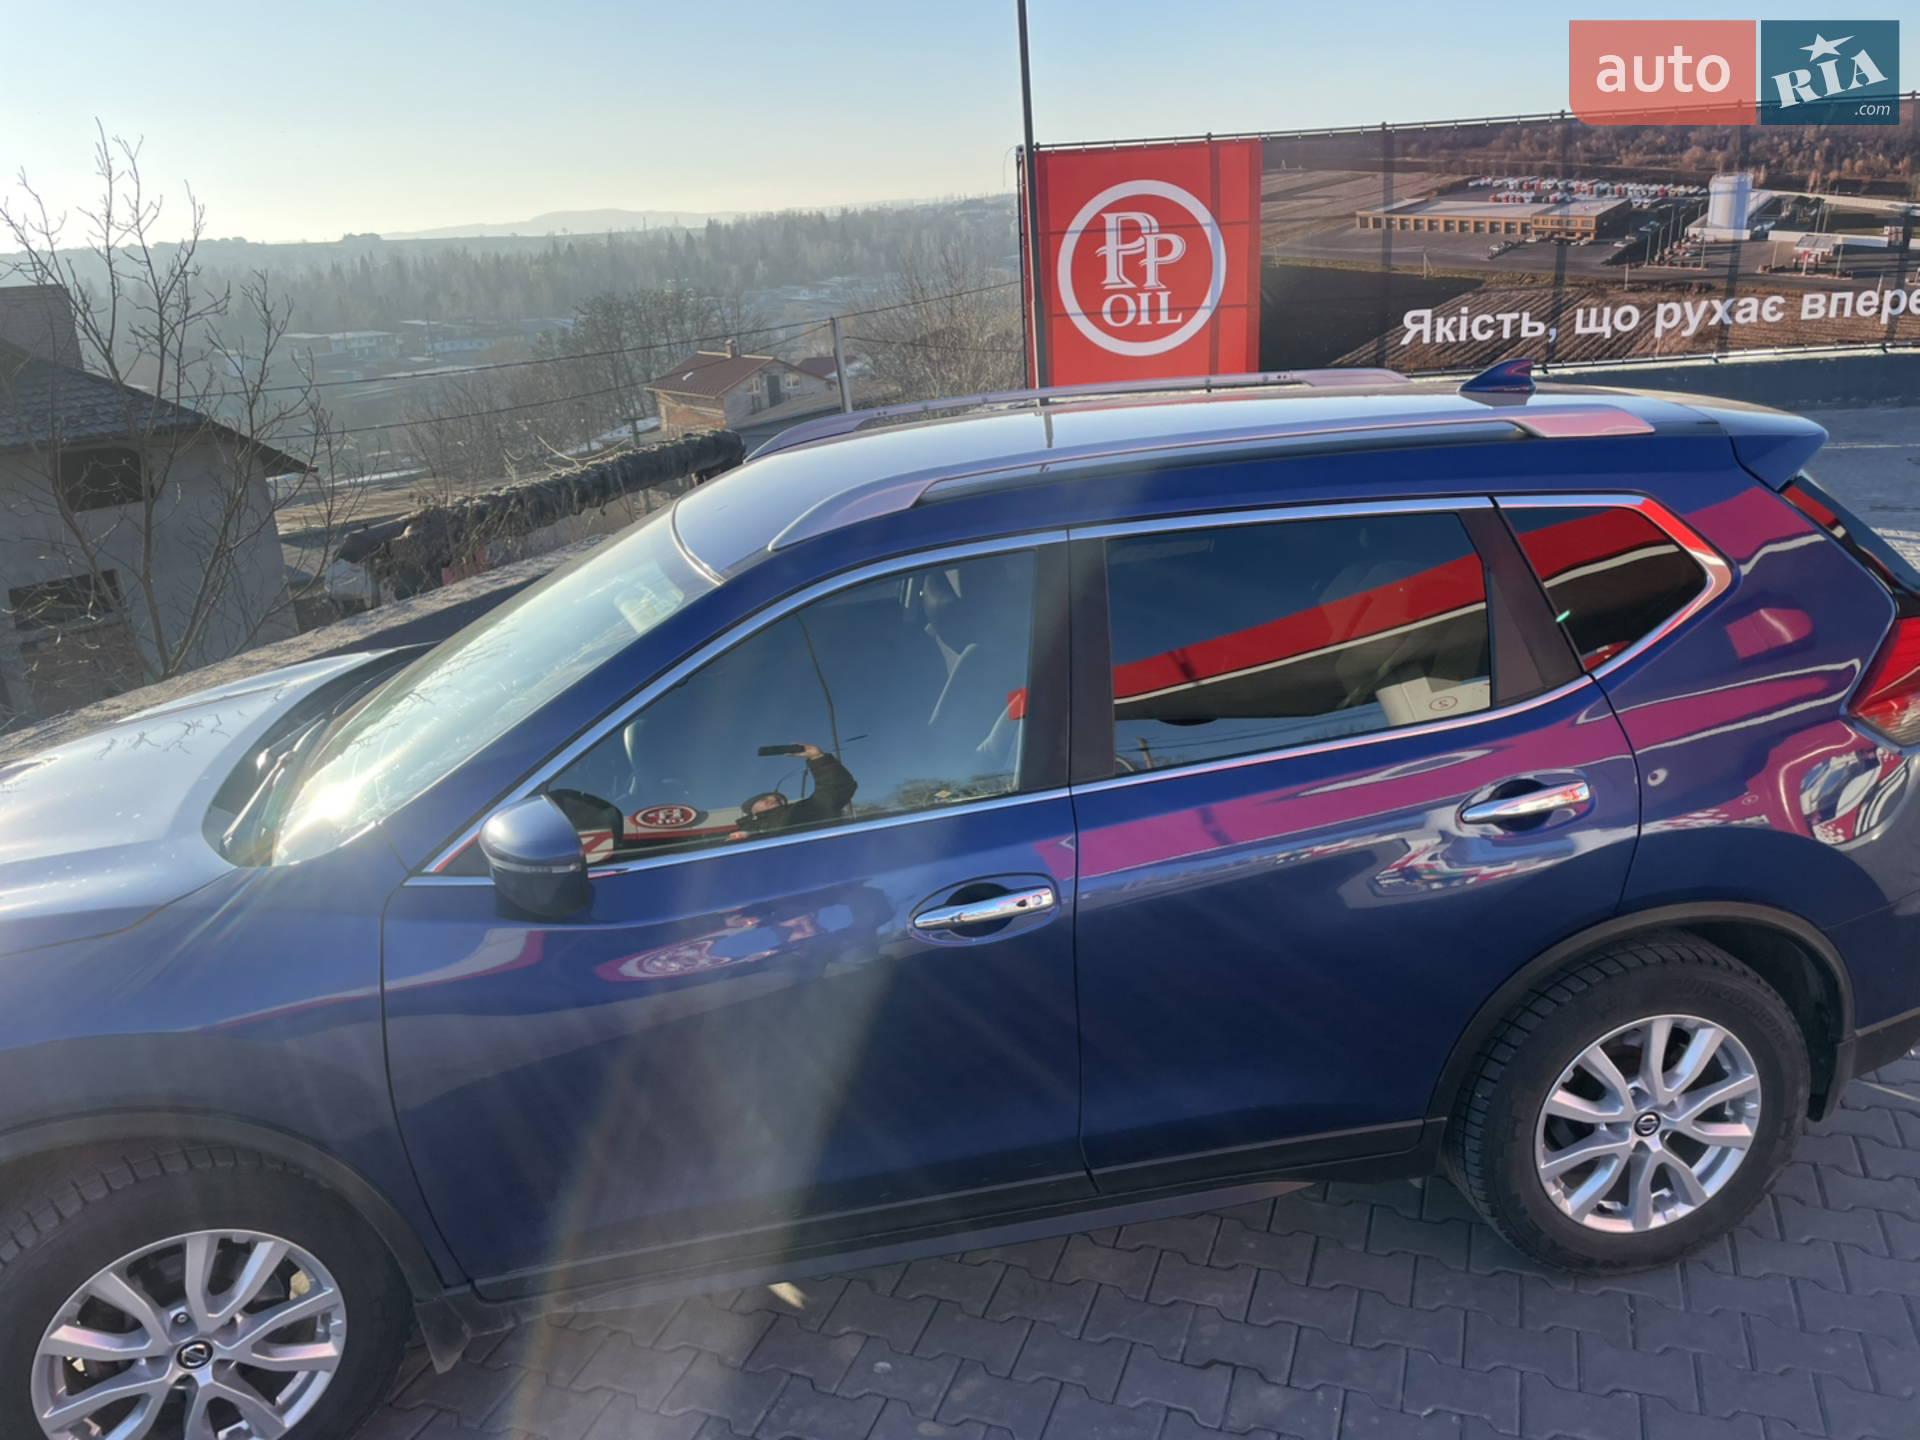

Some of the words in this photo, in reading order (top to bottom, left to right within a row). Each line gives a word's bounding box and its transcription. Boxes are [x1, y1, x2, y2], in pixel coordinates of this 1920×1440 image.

[1095, 211, 1186, 290] PP
[1102, 290, 1182, 327] OIL
[1400, 306, 1557, 345] Якість,
[1574, 304, 1640, 340] що
[1654, 295, 1786, 338] рухає
